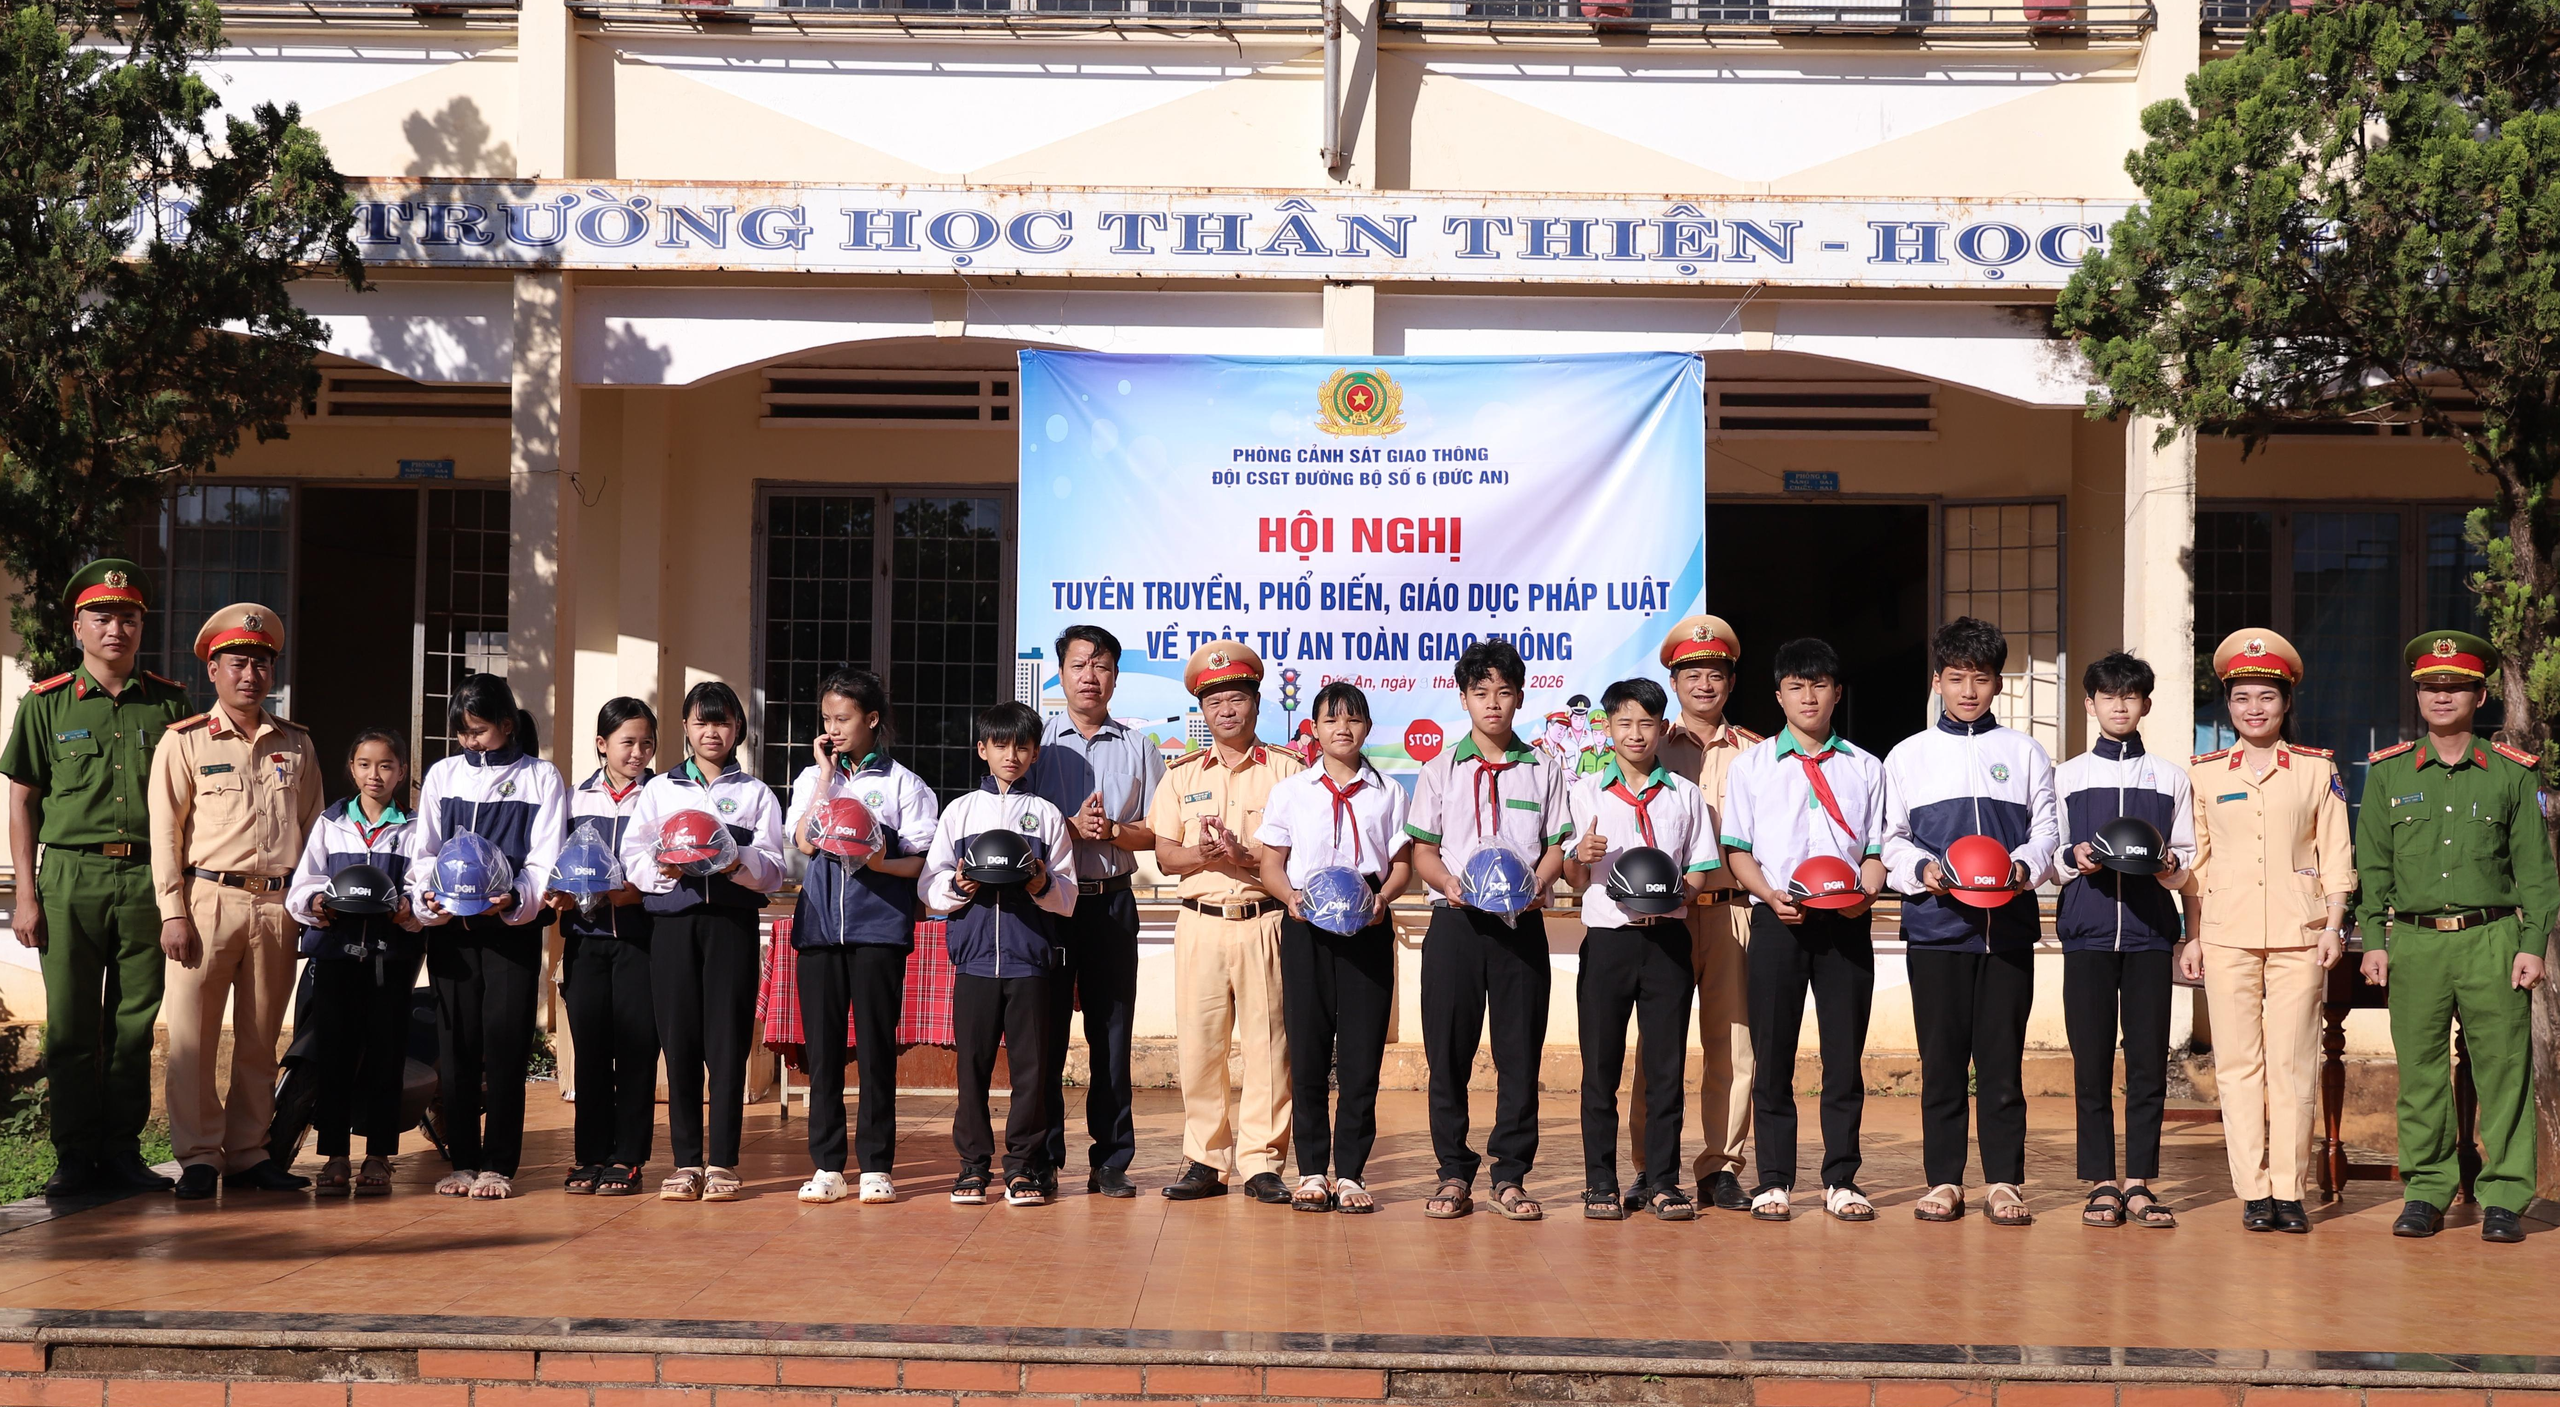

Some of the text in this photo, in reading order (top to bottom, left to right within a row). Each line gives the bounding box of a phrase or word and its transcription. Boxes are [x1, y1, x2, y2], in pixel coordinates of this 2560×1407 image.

[353, 187, 814, 250] TRƯỜNG
[839, 208, 1073, 266] HỌC
[1098, 197, 1416, 258] THÂN
[1443, 203, 1802, 276] THIỆN
[1820, 240, 1849, 252] -
[1867, 221, 2105, 280] HỌC
[1233, 444, 1489, 462] PHÒNG CẢNH SÁT GIAO THÔNG
[1212, 467, 1509, 489] ĐỘI CSGT ĐƯỜNG BỘ SỐ 6 (ĐỨC AN)
[1259, 510, 1461, 562] HỘI NGHỊ
[1052, 570, 1670, 618] TUYÊN TRUYỀN, PHỔ BIẾN, GIÁO DỤC PHÁP LUẬT
[1146, 622, 1178, 660] VỀ
[1257, 628, 1291, 666] TỰ
[1297, 631, 1333, 660] AN
[1342, 626, 1409, 661] TOÀN
[1381, 675, 1416, 692] ngày
[1530, 675, 1564, 689] 2026
[1408, 733, 1442, 747] STOP
[835, 826, 857, 837] DGH
[2125, 845, 2147, 856] DGH
[987, 856, 1009, 865] DGH
[1823, 881, 1845, 891] DGH
[1974, 876, 1996, 885] DGH
[349, 887, 371, 897] DGH
[454, 884, 476, 893] DGH
[1645, 884, 1666, 893] DGH
